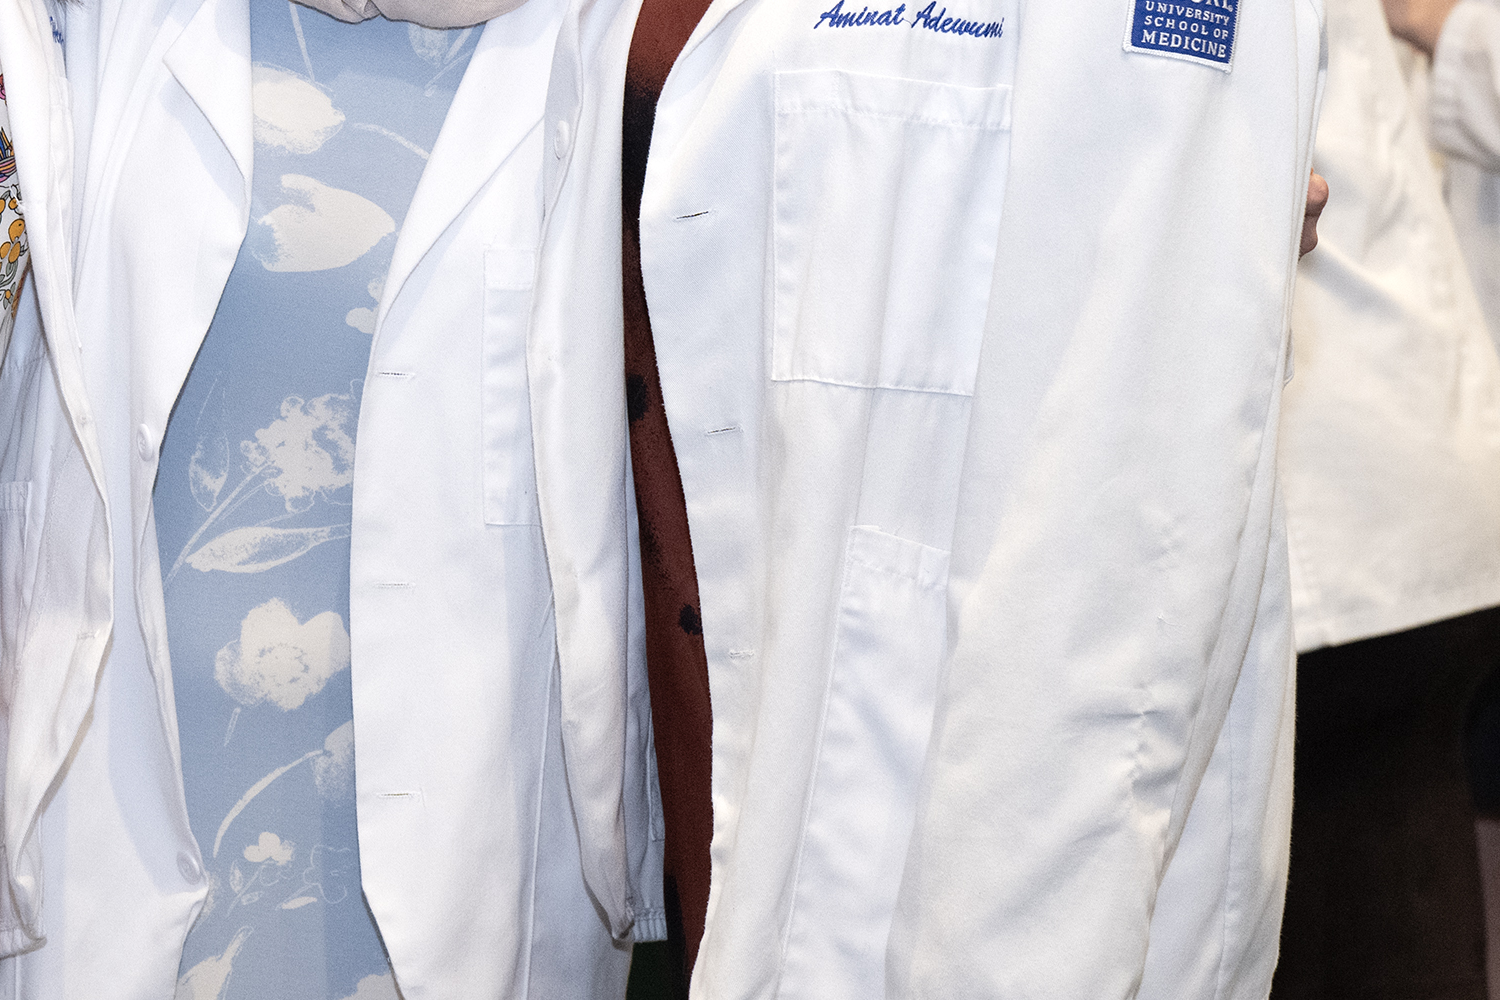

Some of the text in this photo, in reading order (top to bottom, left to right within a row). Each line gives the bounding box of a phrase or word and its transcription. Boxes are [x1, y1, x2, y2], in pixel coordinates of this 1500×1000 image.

[814, 0, 1005, 38] Aminat Adewumi
[1145, 0, 1230, 26] UNIVERSITY
[1144, 15, 1229, 40] SCHOOL OF
[1141, 29, 1227, 58] MEDICINE
